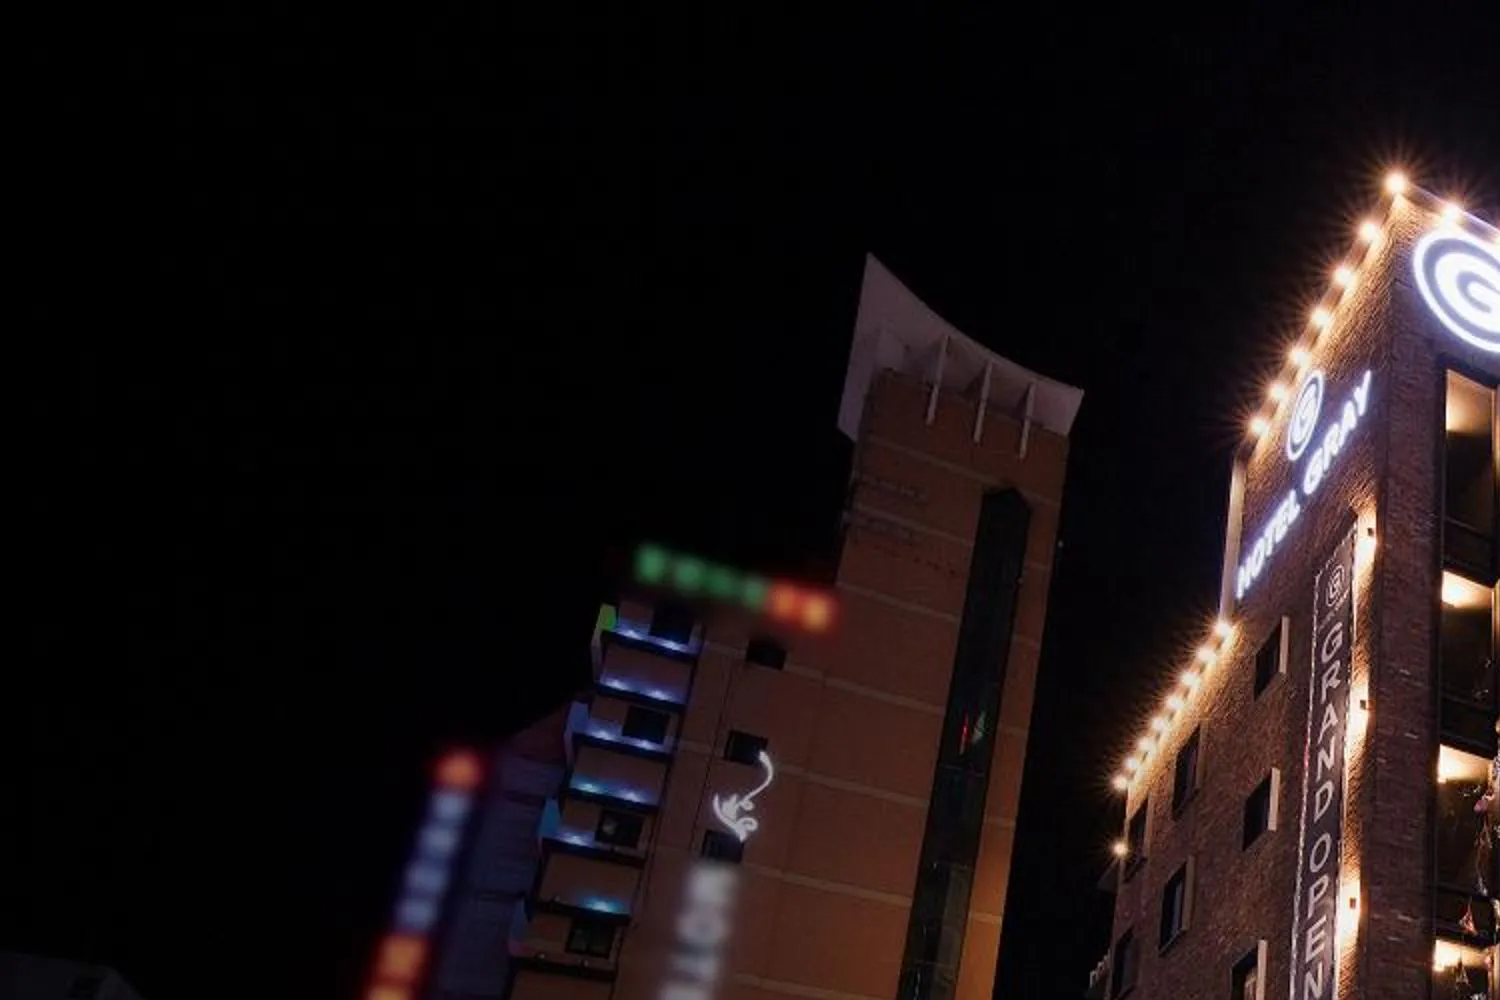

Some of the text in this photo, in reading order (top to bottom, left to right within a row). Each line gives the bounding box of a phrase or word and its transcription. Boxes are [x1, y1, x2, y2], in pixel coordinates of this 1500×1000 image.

[1236, 369, 1372, 600] HOTEL GRAY
[1313, 620, 1344, 823] GRAND
